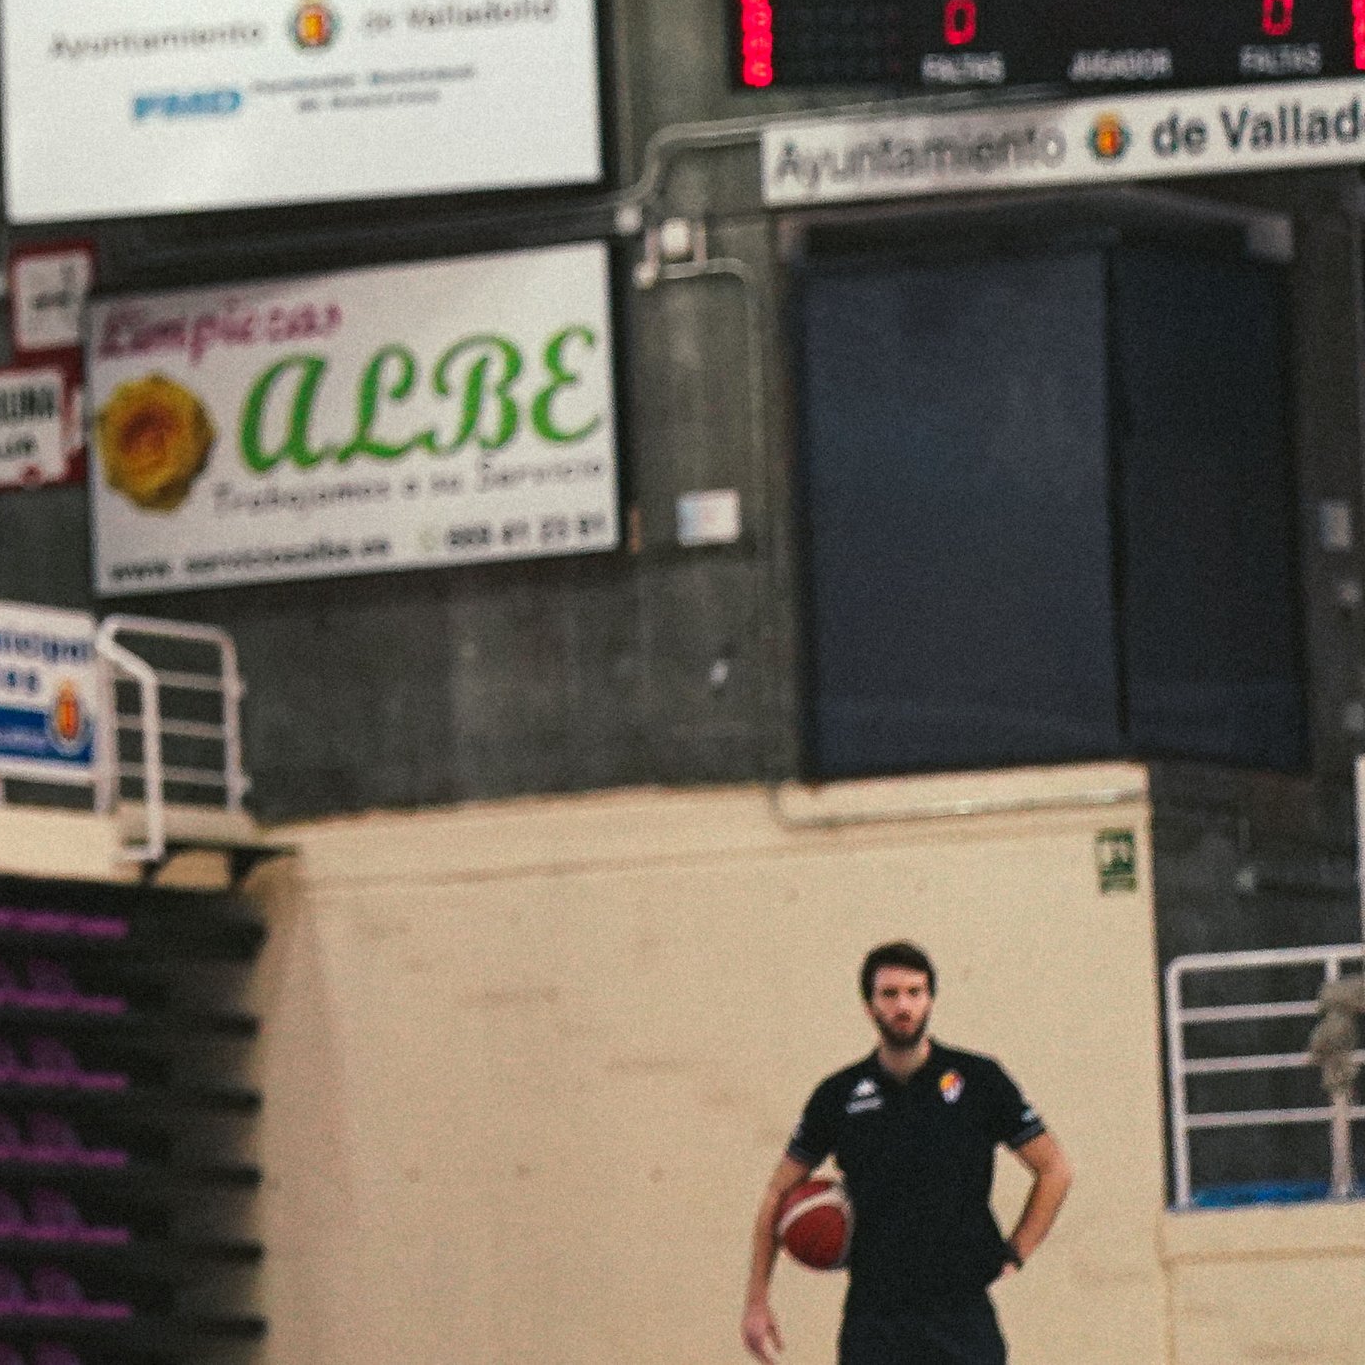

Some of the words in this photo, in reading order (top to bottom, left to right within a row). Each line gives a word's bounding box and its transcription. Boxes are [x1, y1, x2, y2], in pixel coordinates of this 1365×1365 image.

[774, 122, 1068, 187] Ayuntamiento
[1151, 109, 1207, 158] de
[1220, 95, 1365, 152] Vallad
[236, 324, 605, 474] ALBE
